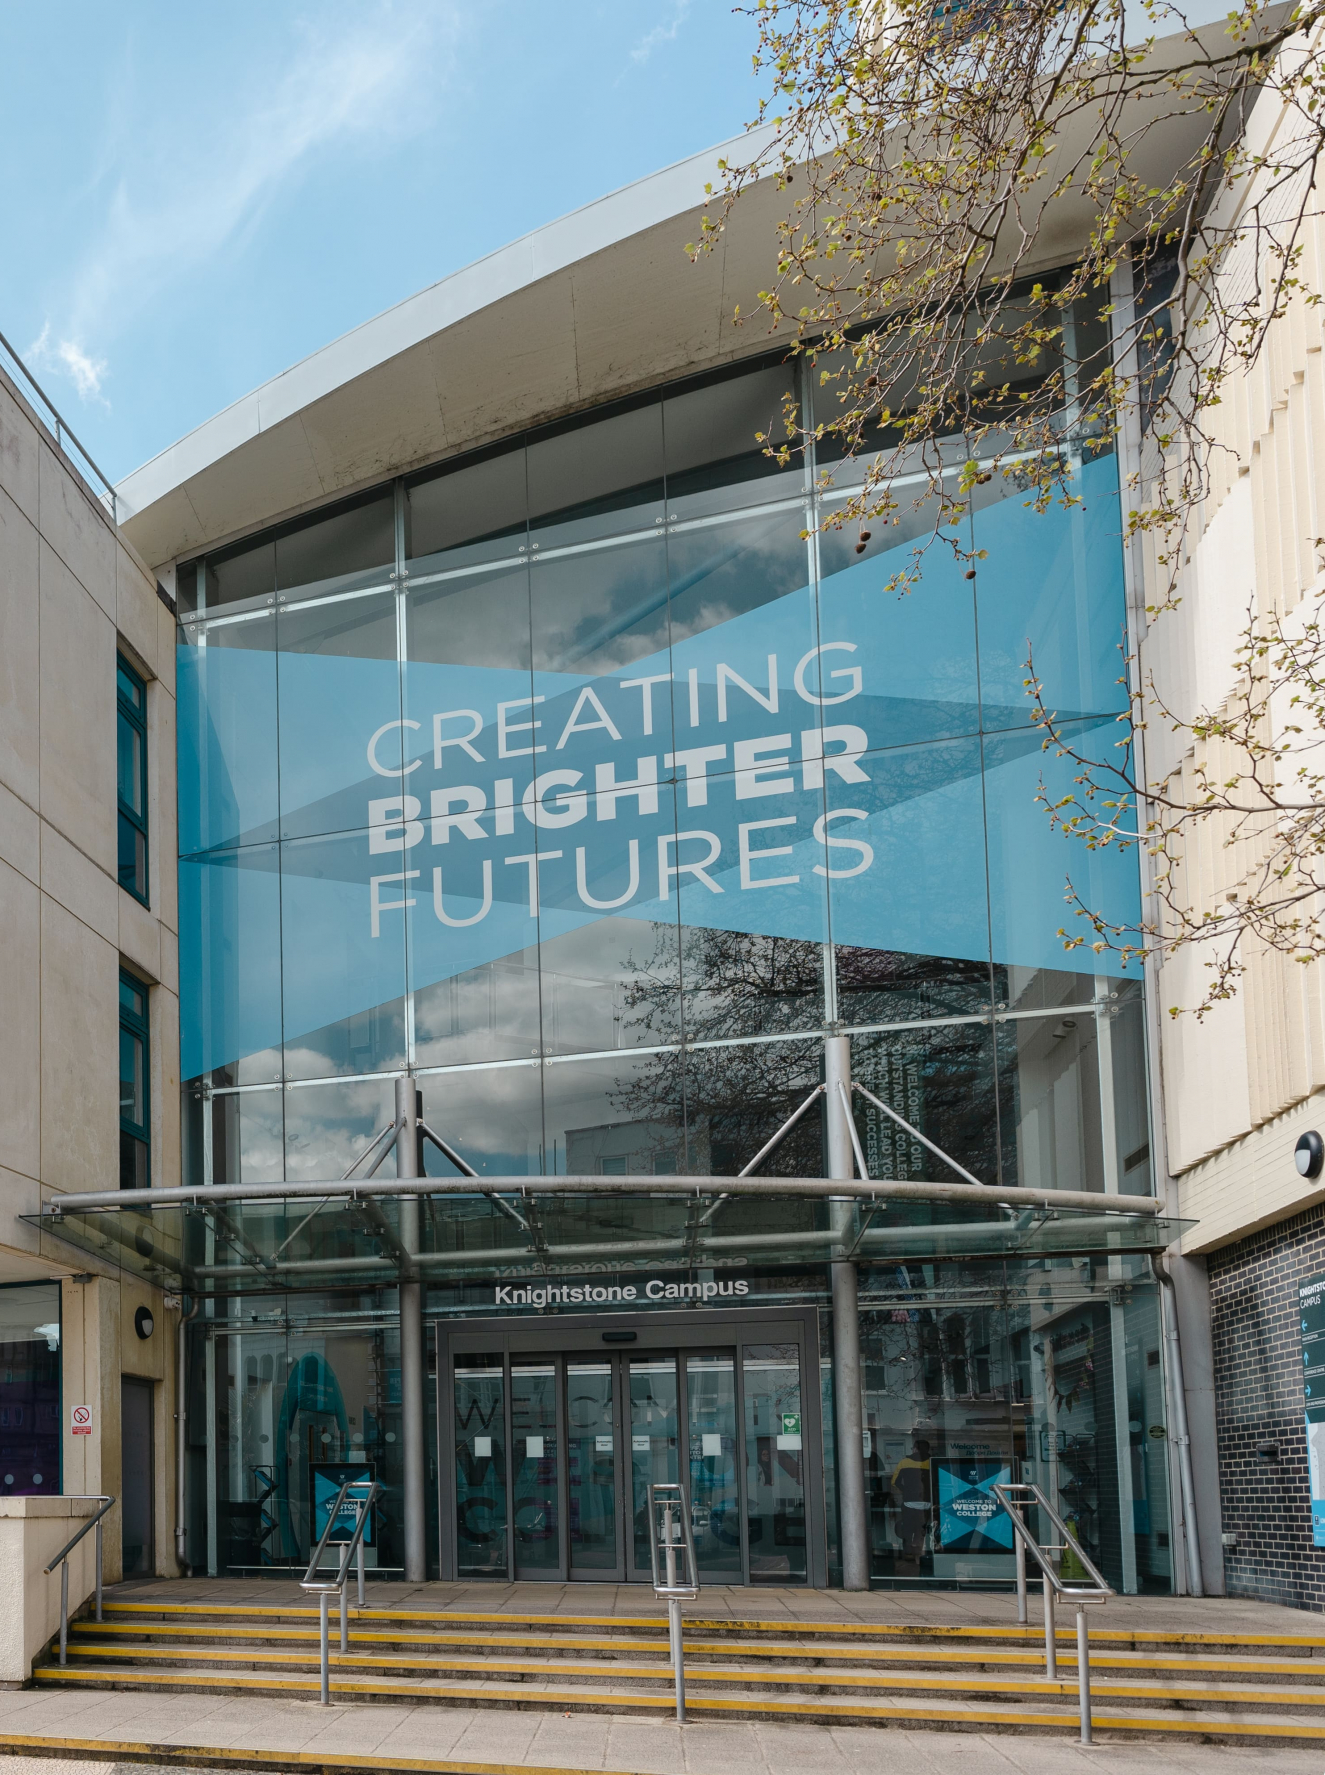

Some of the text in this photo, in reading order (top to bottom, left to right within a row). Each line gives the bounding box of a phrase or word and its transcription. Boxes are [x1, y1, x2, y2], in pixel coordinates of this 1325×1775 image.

[367, 642, 863, 778] CREATING
[368, 724, 871, 855] BRIGHTER
[369, 808, 874, 938] FUTURES
[906, 1063, 920, 1123] WELCOME
[866, 1108, 879, 1177] SUCCESSES
[895, 1133, 908, 1181] COLLEG
[911, 1145, 922, 1171] OUR
[495, 1280, 750, 1308] Knightstone Campus
[1300, 1294, 1321, 1309] CAMPUS
[952, 1503, 996, 1511] WESTON
